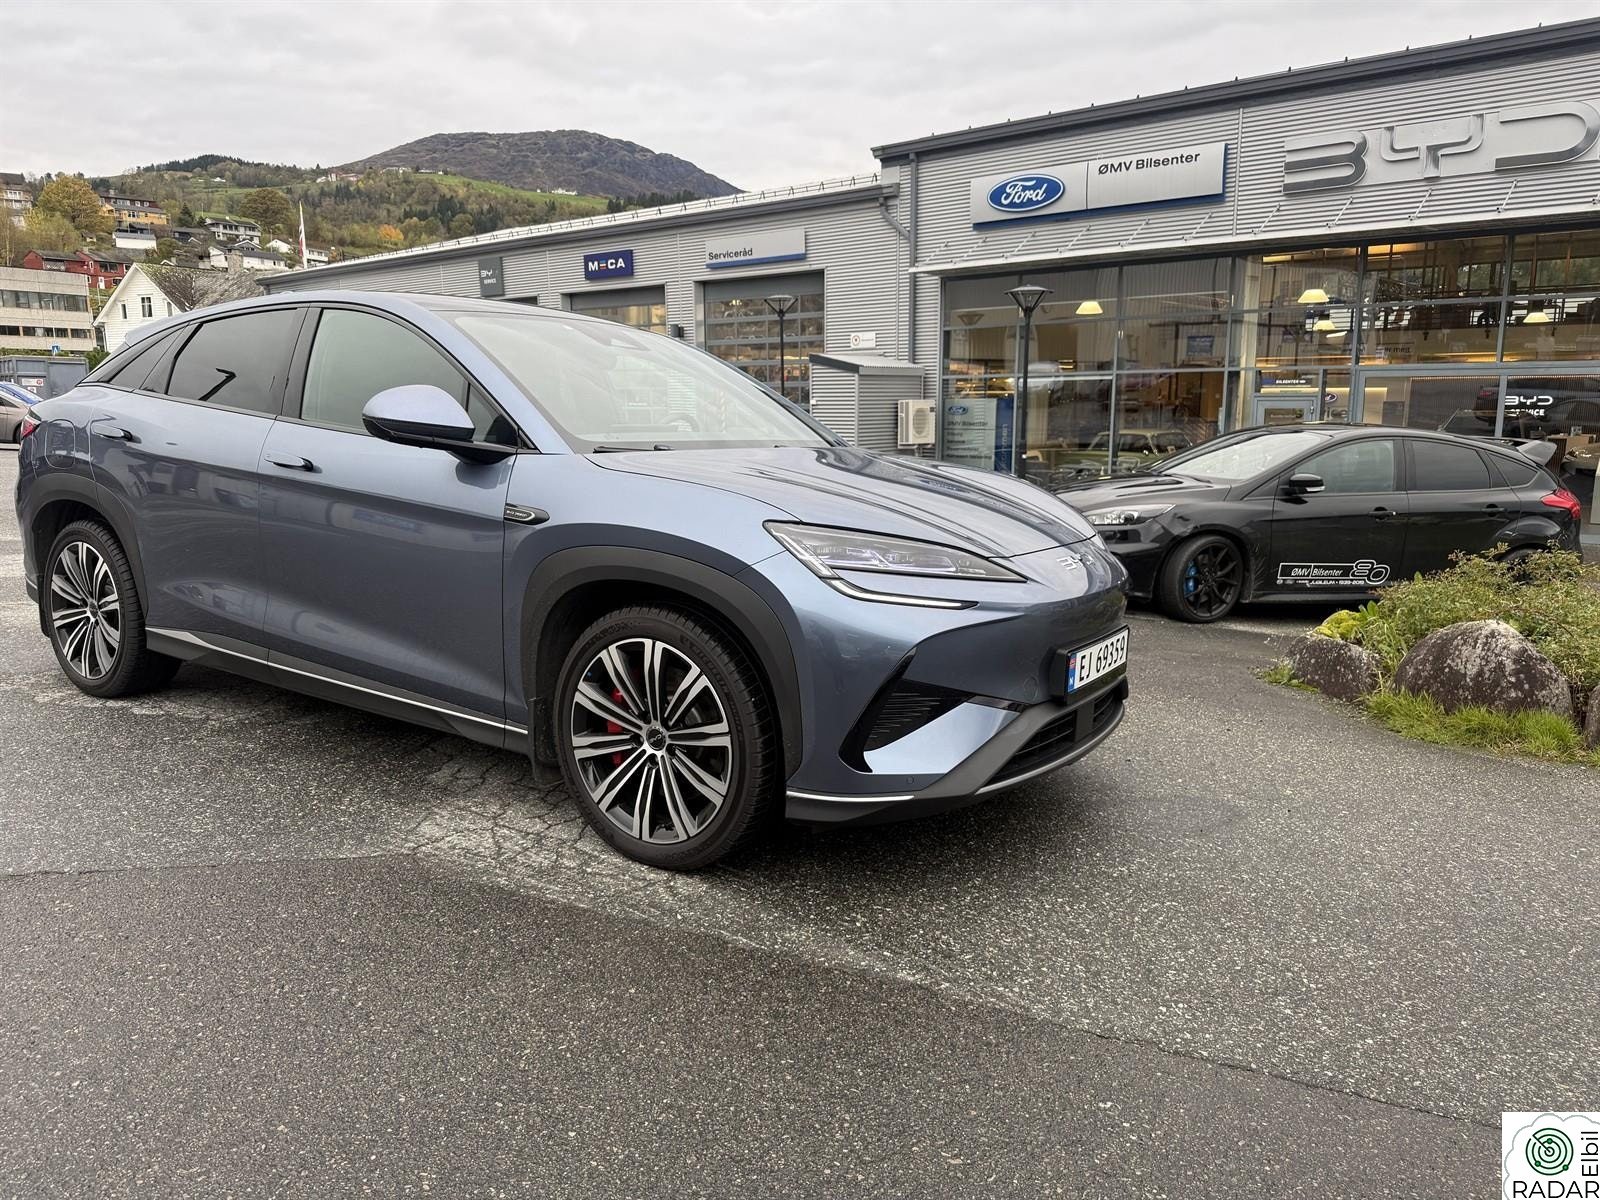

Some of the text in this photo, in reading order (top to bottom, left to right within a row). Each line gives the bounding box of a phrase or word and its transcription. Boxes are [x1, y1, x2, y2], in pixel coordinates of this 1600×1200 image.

[1281, 101, 1600, 195] BYD
[1098, 152, 1201, 175] ØMV Bilsenter
[1001, 179, 1048, 205] Ford
[708, 247, 754, 261] Serviceråd
[1504, 395, 1554, 406] BYD
[1291, 567, 1344, 577] ØMV Bilsenter
[1349, 560, 1390, 584] 80
[1078, 635, 1126, 682] EJ 69359
